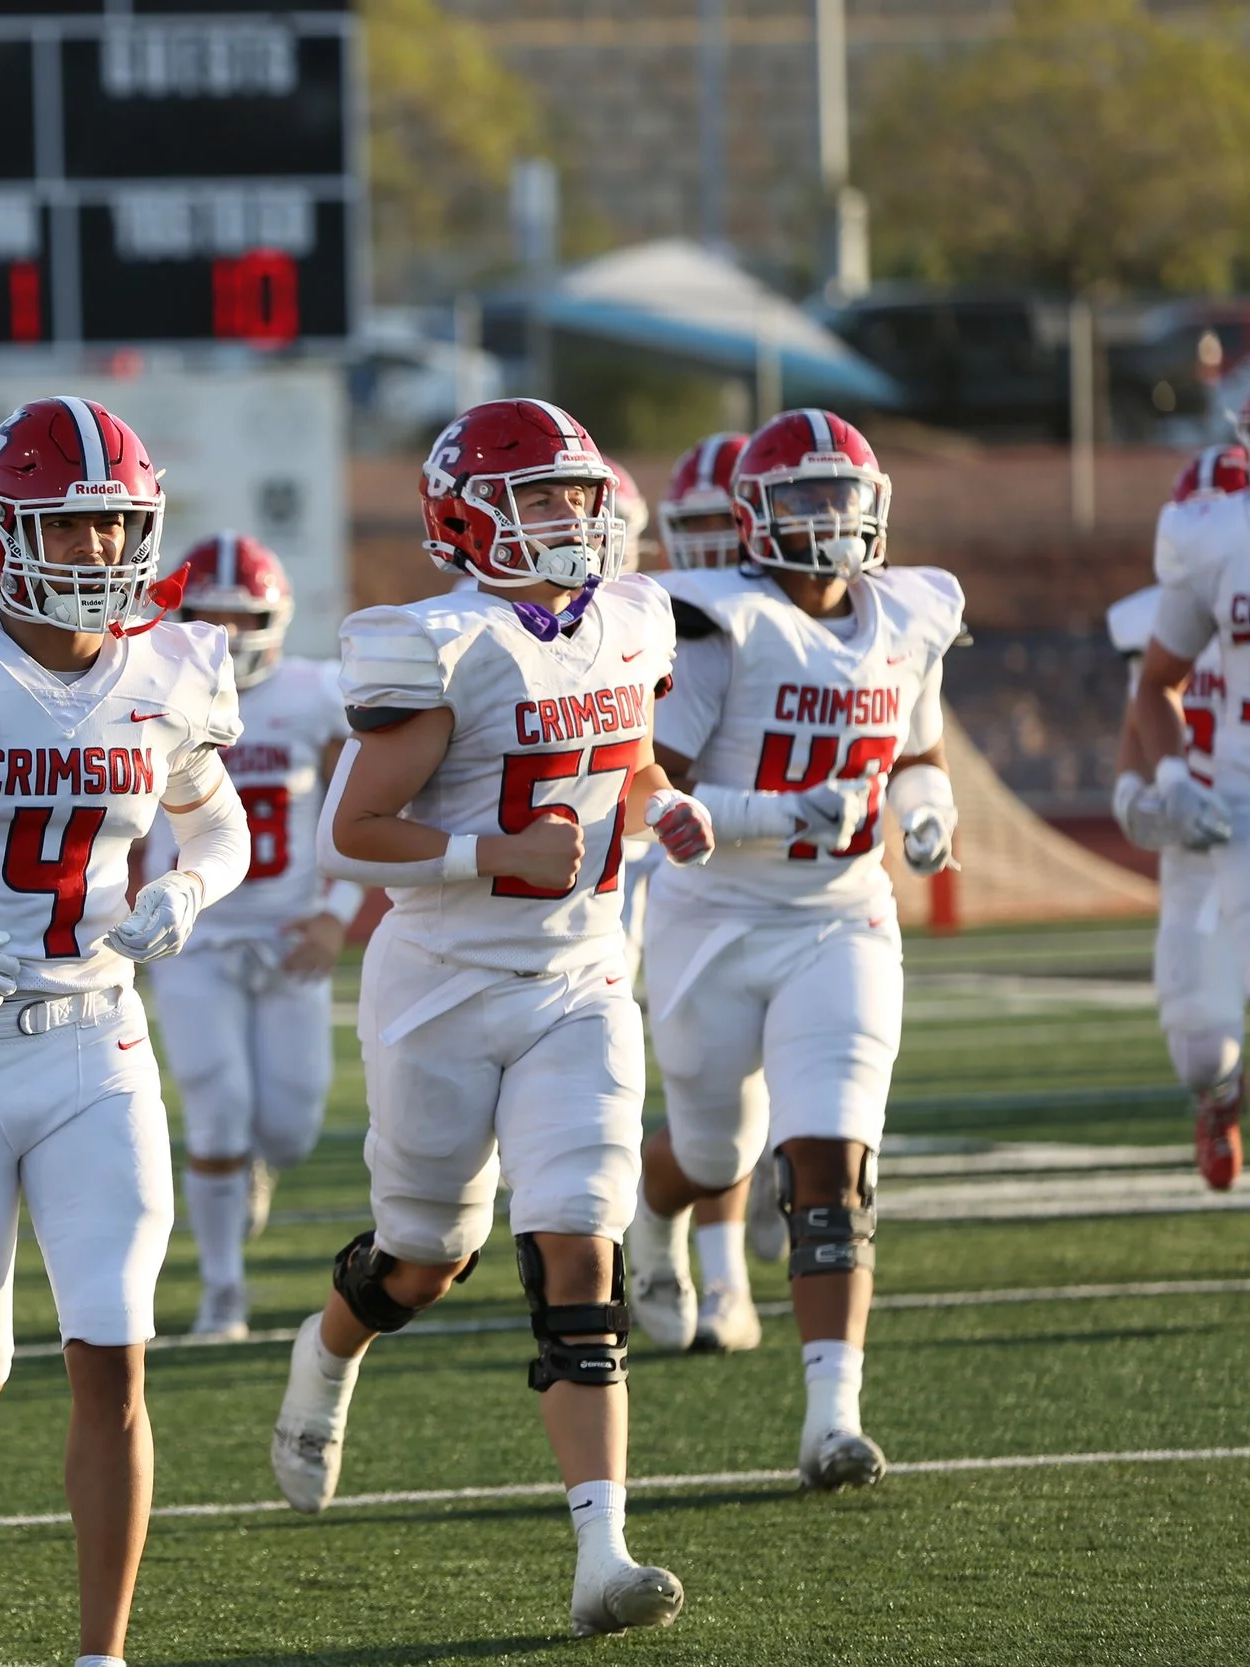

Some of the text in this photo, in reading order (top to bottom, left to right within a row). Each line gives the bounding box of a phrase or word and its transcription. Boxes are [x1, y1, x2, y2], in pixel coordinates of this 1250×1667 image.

[75, 483, 122, 495] Riddell
[515, 683, 647, 745] CRIMSON
[775, 683, 901, 726] CRIMSON
[491, 738, 642, 899] 57
[2, 806, 107, 959] 4
